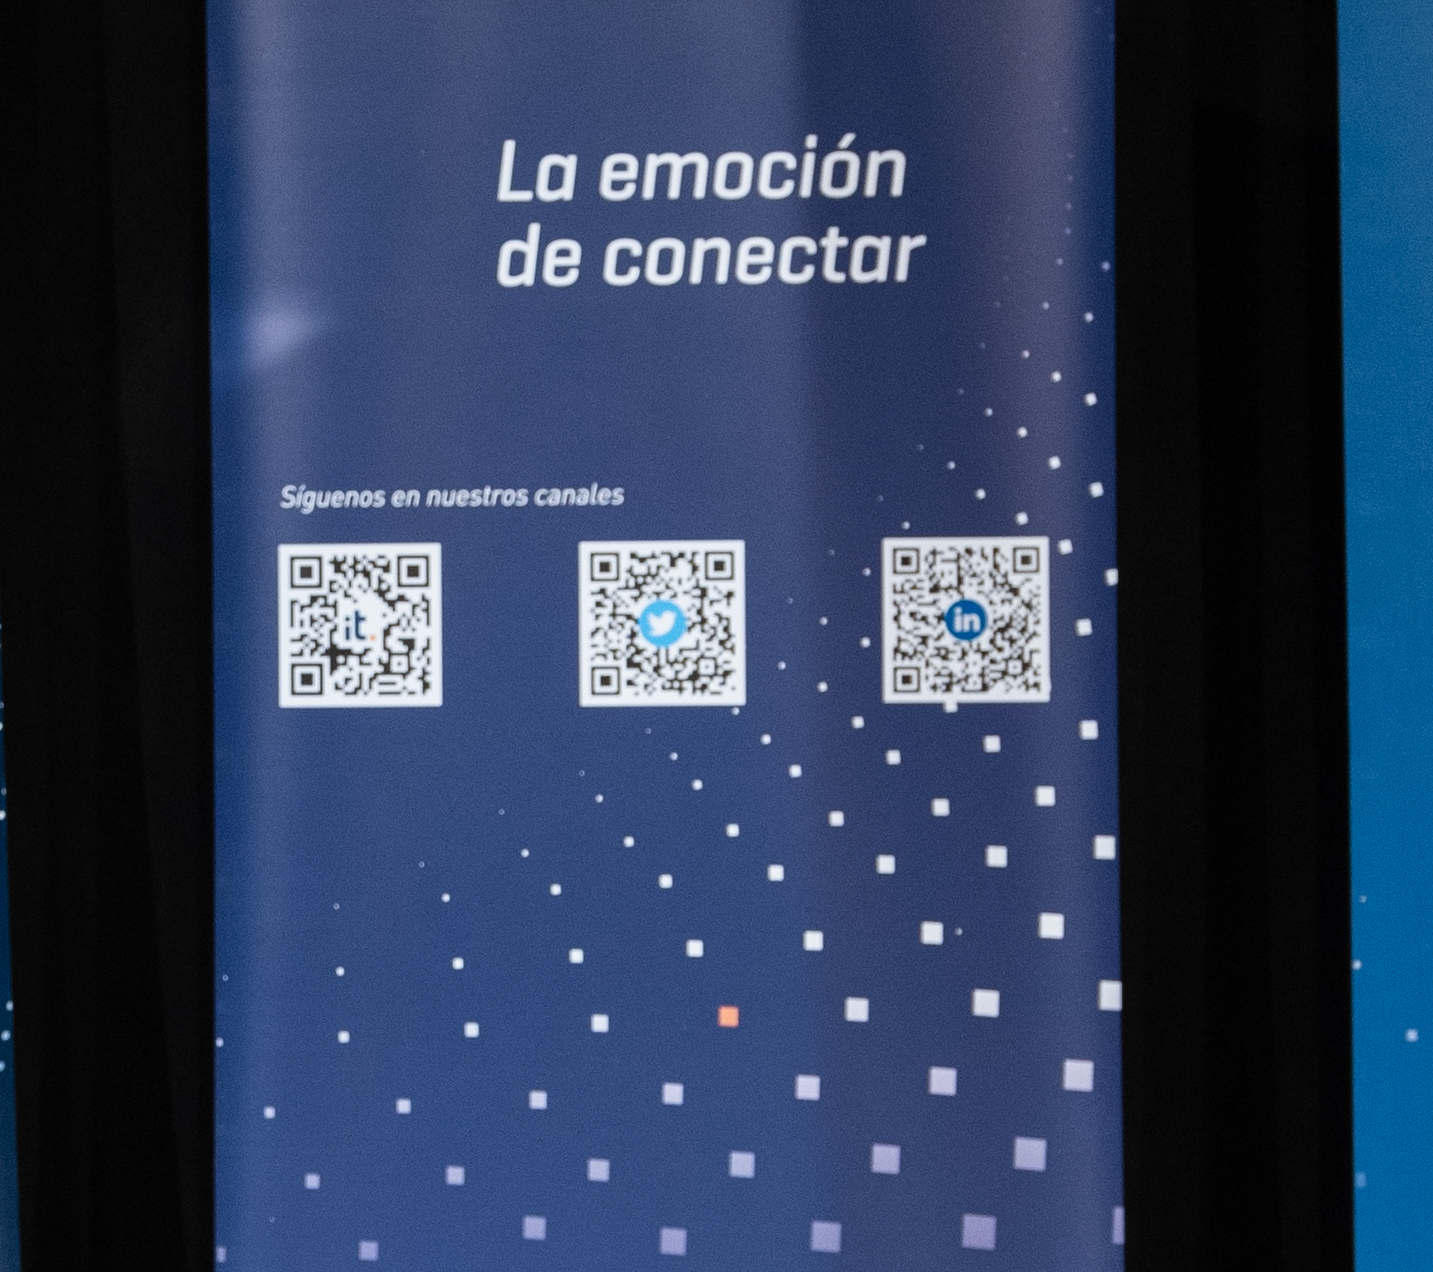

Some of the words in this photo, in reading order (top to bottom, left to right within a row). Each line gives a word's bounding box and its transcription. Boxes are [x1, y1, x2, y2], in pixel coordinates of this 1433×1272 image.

[496, 139, 578, 202] La
[599, 132, 907, 202] emoción
[496, 222, 582, 287] de
[603, 225, 928, 287] conectar
[278, 483, 387, 516] Síguenos
[391, 487, 422, 508] en
[426, 485, 530, 508] nuestros
[534, 482, 624, 507] canales
